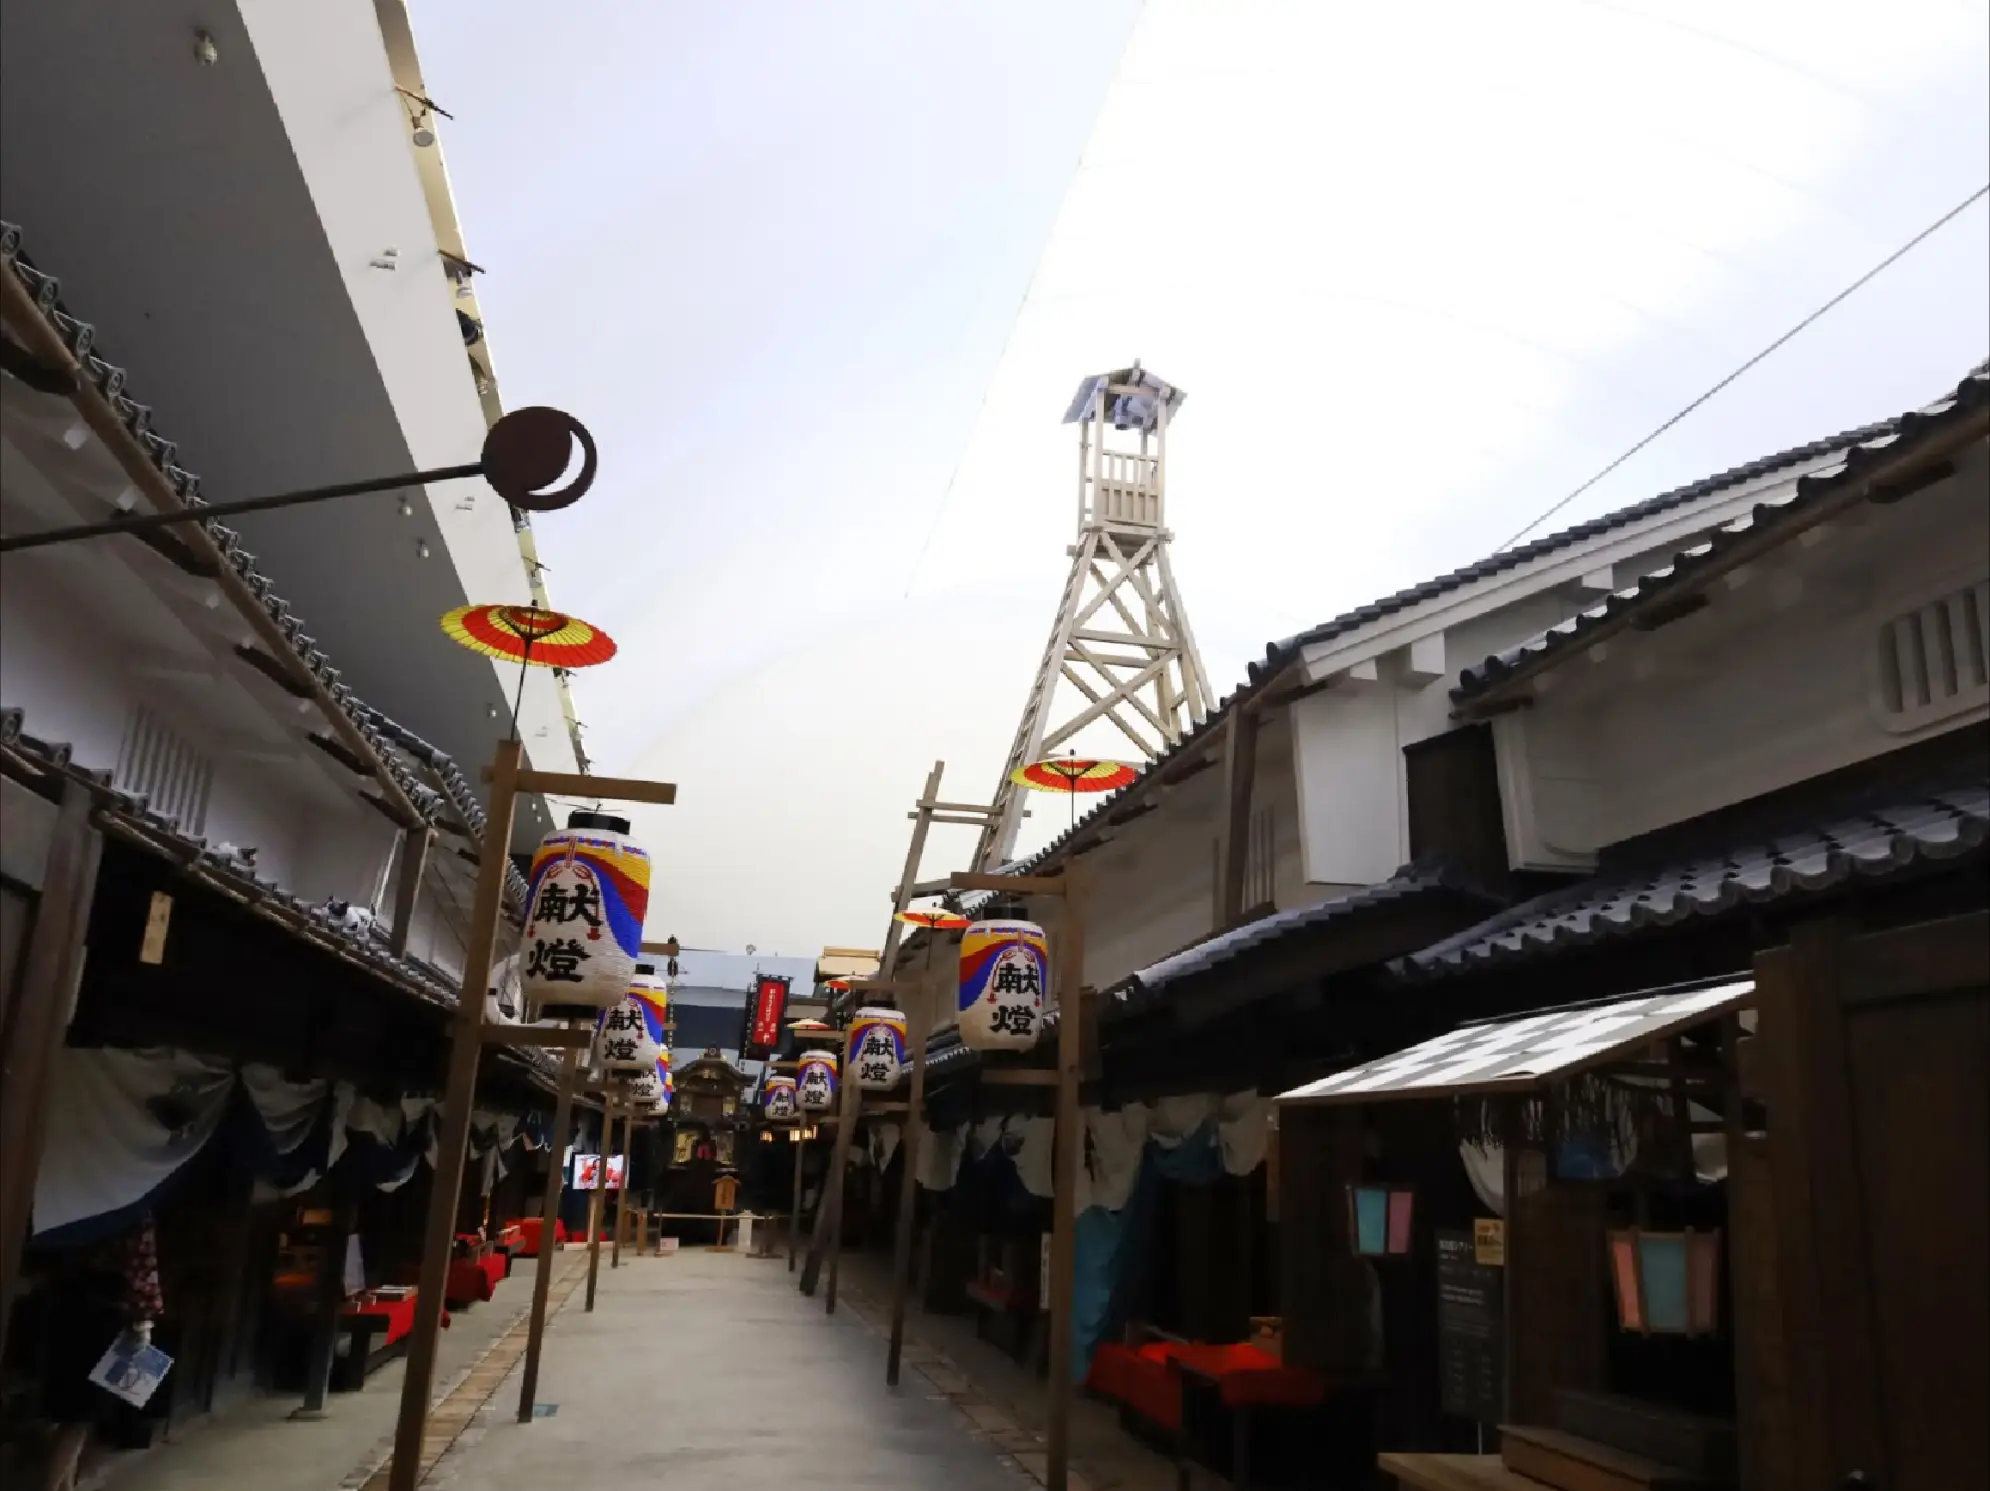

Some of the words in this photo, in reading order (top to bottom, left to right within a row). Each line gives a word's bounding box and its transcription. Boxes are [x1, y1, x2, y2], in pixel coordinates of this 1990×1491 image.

[526, 882, 603, 983] 献燈
[990, 962, 1041, 1036] 献燈
[604, 1010, 643, 1060] 献燈
[861, 1036, 893, 1082] 献燈
